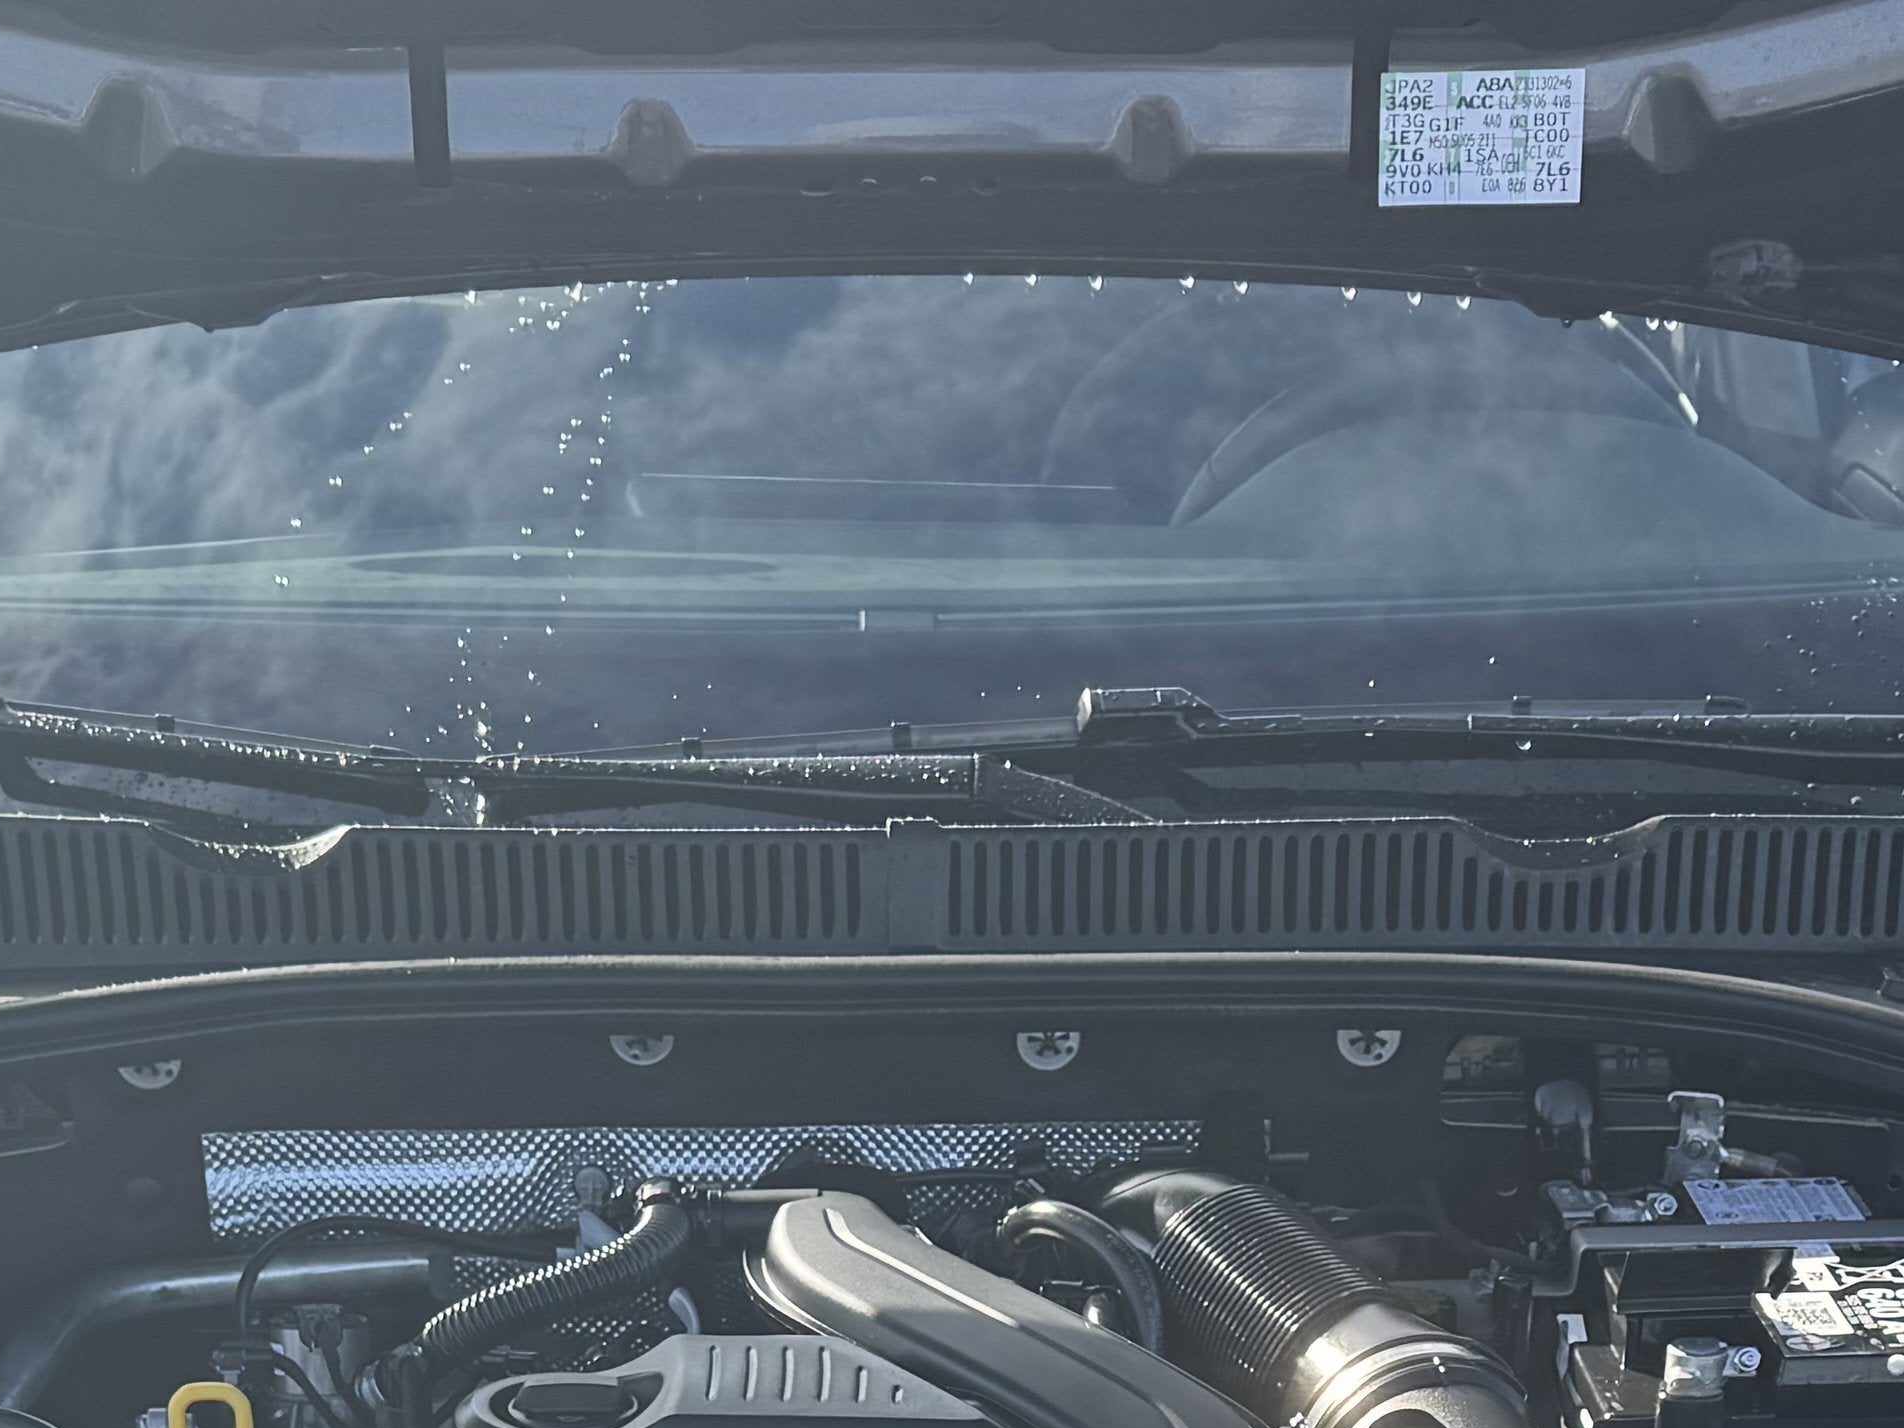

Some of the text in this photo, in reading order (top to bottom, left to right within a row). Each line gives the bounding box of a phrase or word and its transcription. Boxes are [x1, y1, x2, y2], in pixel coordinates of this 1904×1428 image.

[1385, 95, 1434, 111] 349E
[1389, 130, 1424, 146] 1E7
[1388, 147, 1425, 163] 7L6
[1536, 162, 1571, 177] 7L6
